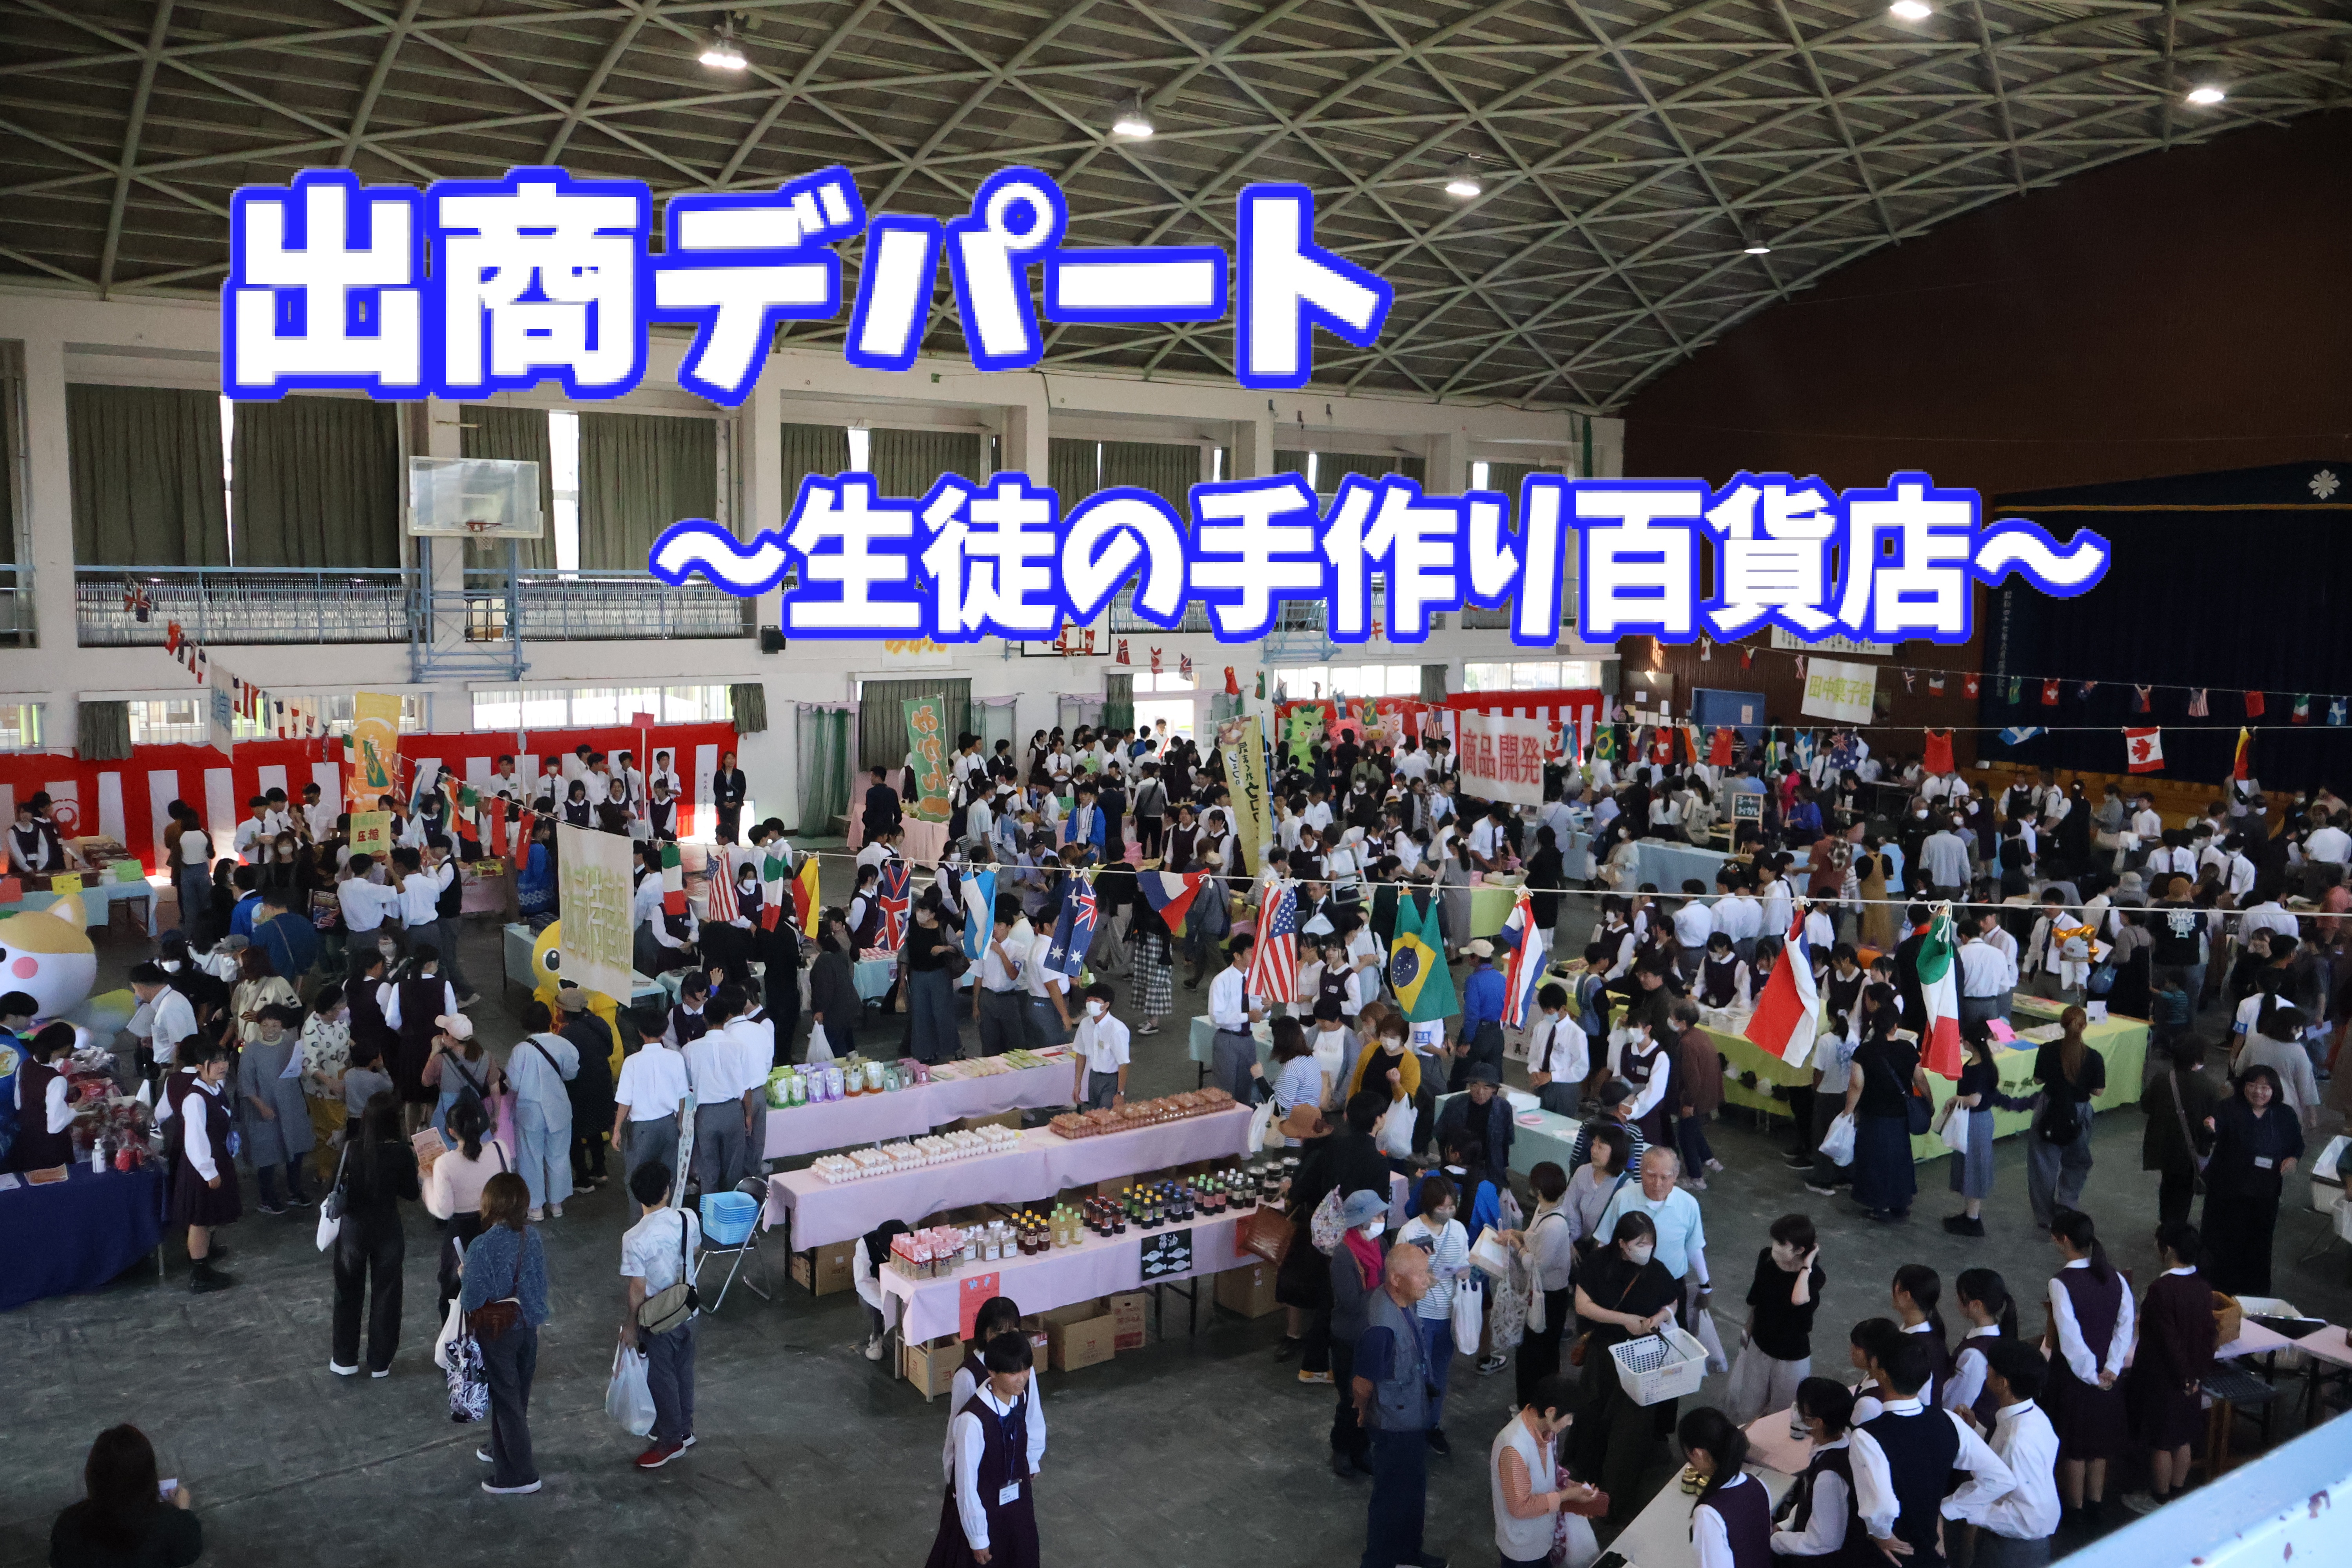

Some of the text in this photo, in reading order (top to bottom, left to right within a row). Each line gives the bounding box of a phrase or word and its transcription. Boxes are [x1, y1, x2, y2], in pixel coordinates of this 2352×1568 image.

[1808, 675, 1872, 706] 田中菓子店
[1463, 729, 1540, 784] 商品開発
